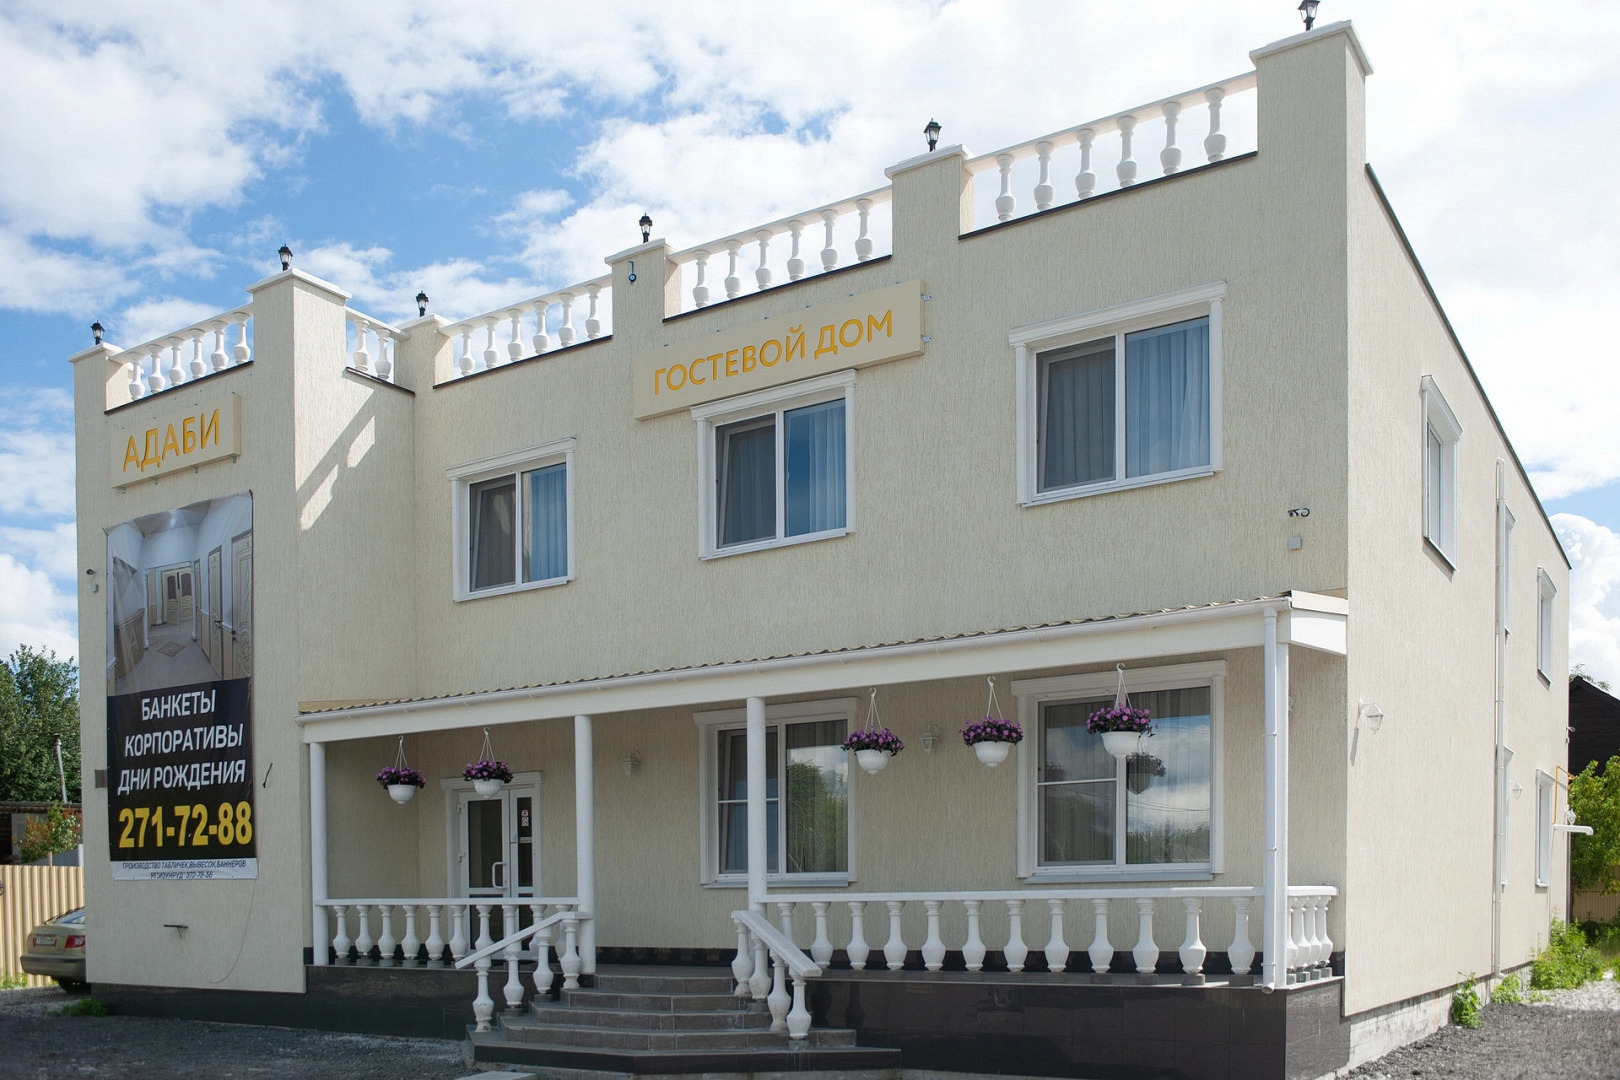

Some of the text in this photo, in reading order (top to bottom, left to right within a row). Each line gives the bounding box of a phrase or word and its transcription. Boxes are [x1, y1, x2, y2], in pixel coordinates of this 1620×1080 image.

[654, 309, 893, 395] ГОСТЕВОЙ ДОМ
[122, 408, 219, 473] АДАБИ
[142, 689, 216, 721] БАНКЕТЫ
[124, 723, 244, 757] КОРПОРАТИВЫ
[117, 759, 246, 796] ДНИ РОЖДЕНИЯ
[119, 801, 252, 848] 271-72-88
[122, 862, 161, 870] ПРОИЗВОДСТВО
